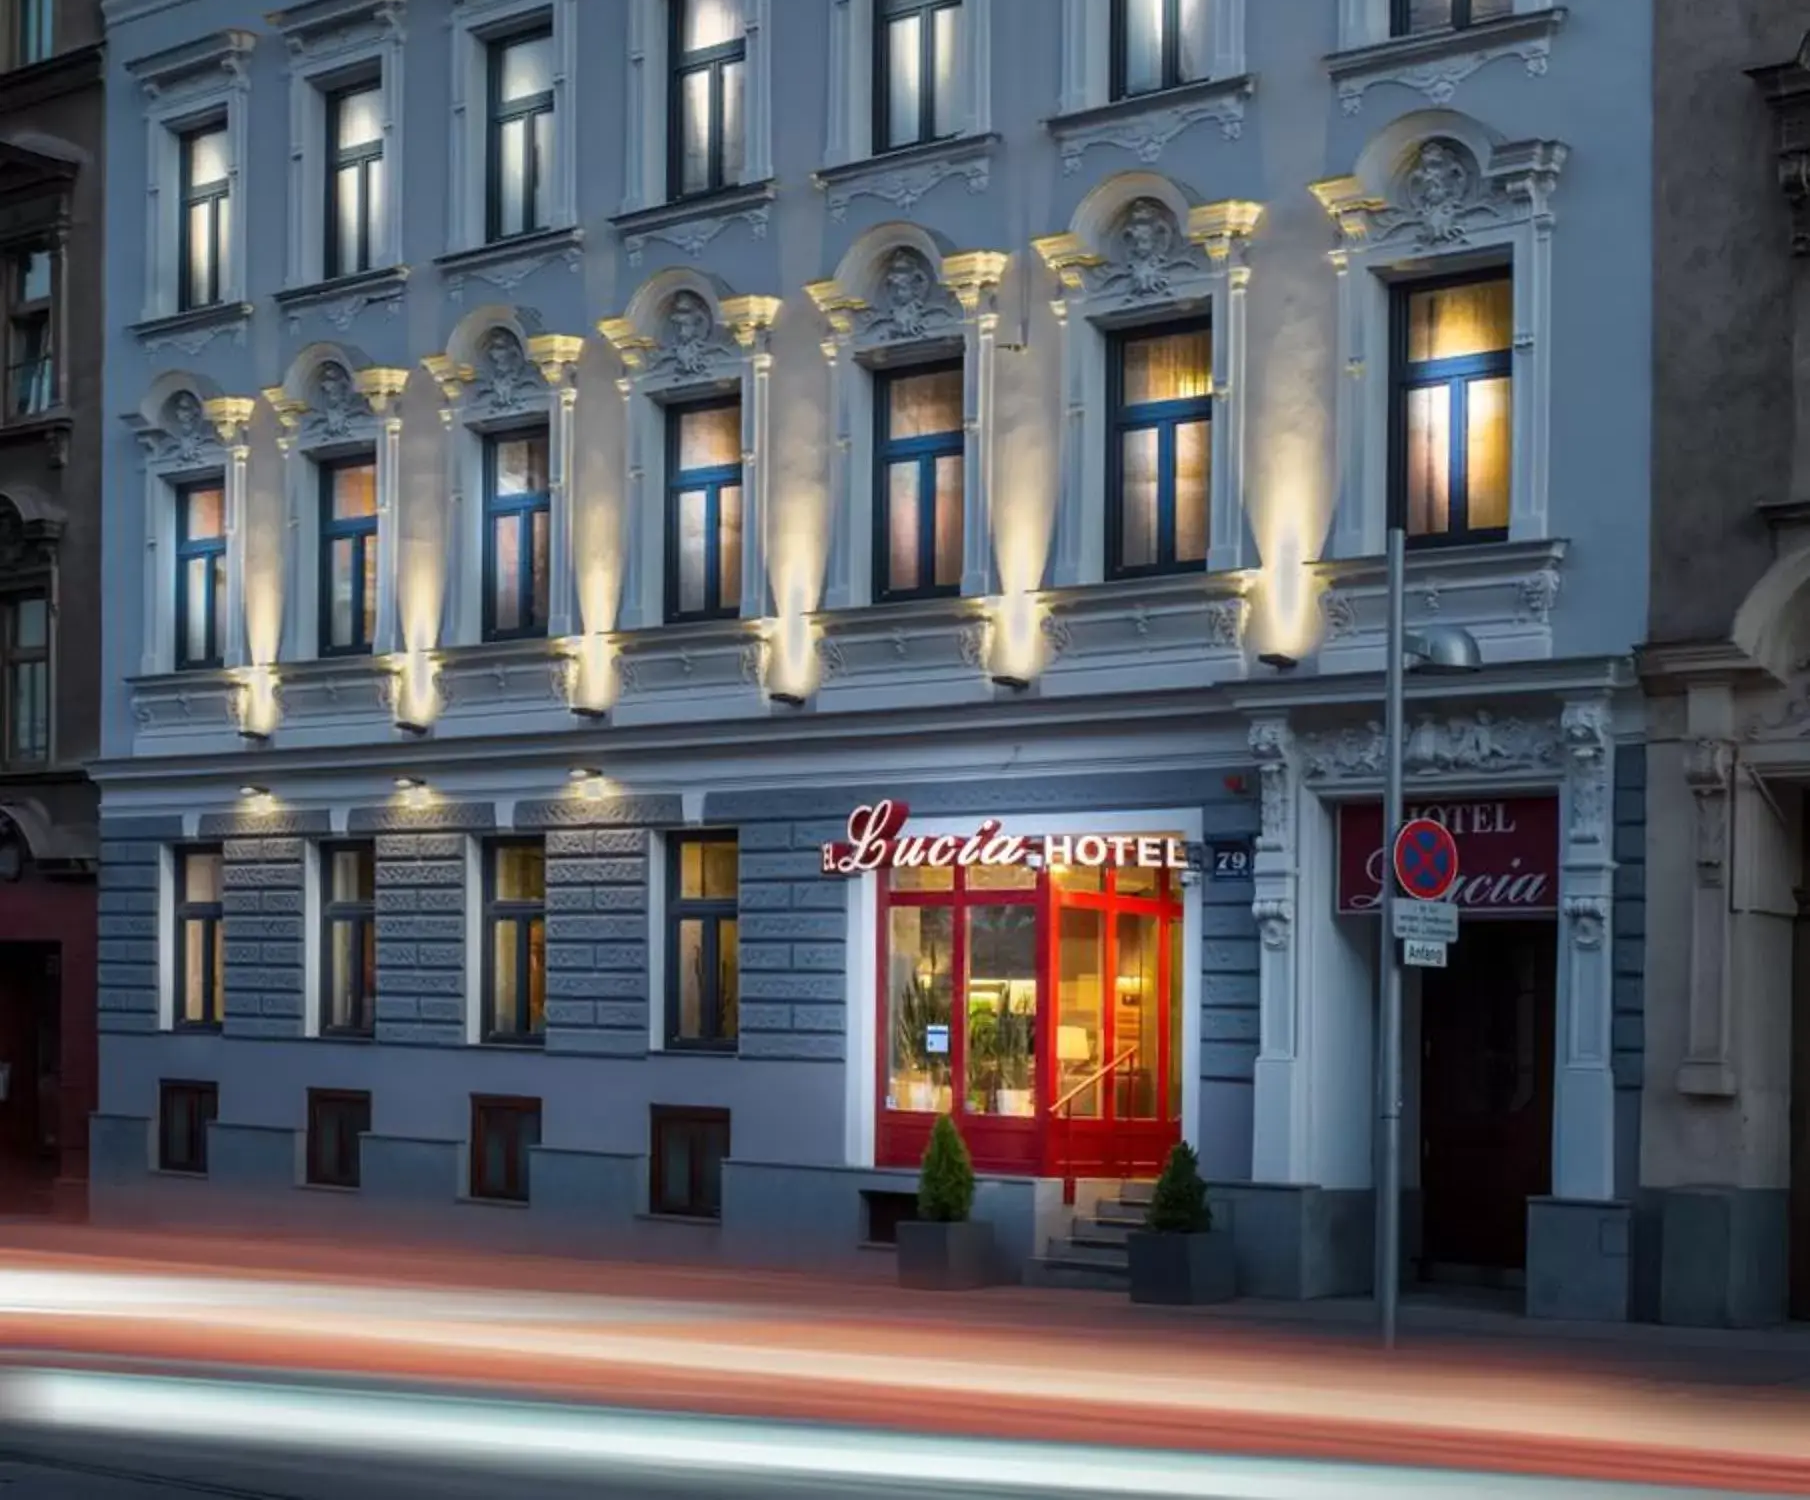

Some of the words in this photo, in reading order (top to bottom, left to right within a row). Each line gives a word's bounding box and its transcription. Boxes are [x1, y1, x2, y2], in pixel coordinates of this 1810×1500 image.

[1401, 803, 1517, 835] OTEL
[837, 799, 1027, 873] Lucia
[1043, 835, 1189, 869] HOTEL
[1216, 851, 1247, 871] 79
[1349, 848, 1549, 909] cia
[1408, 944, 1443, 965] Anfang
